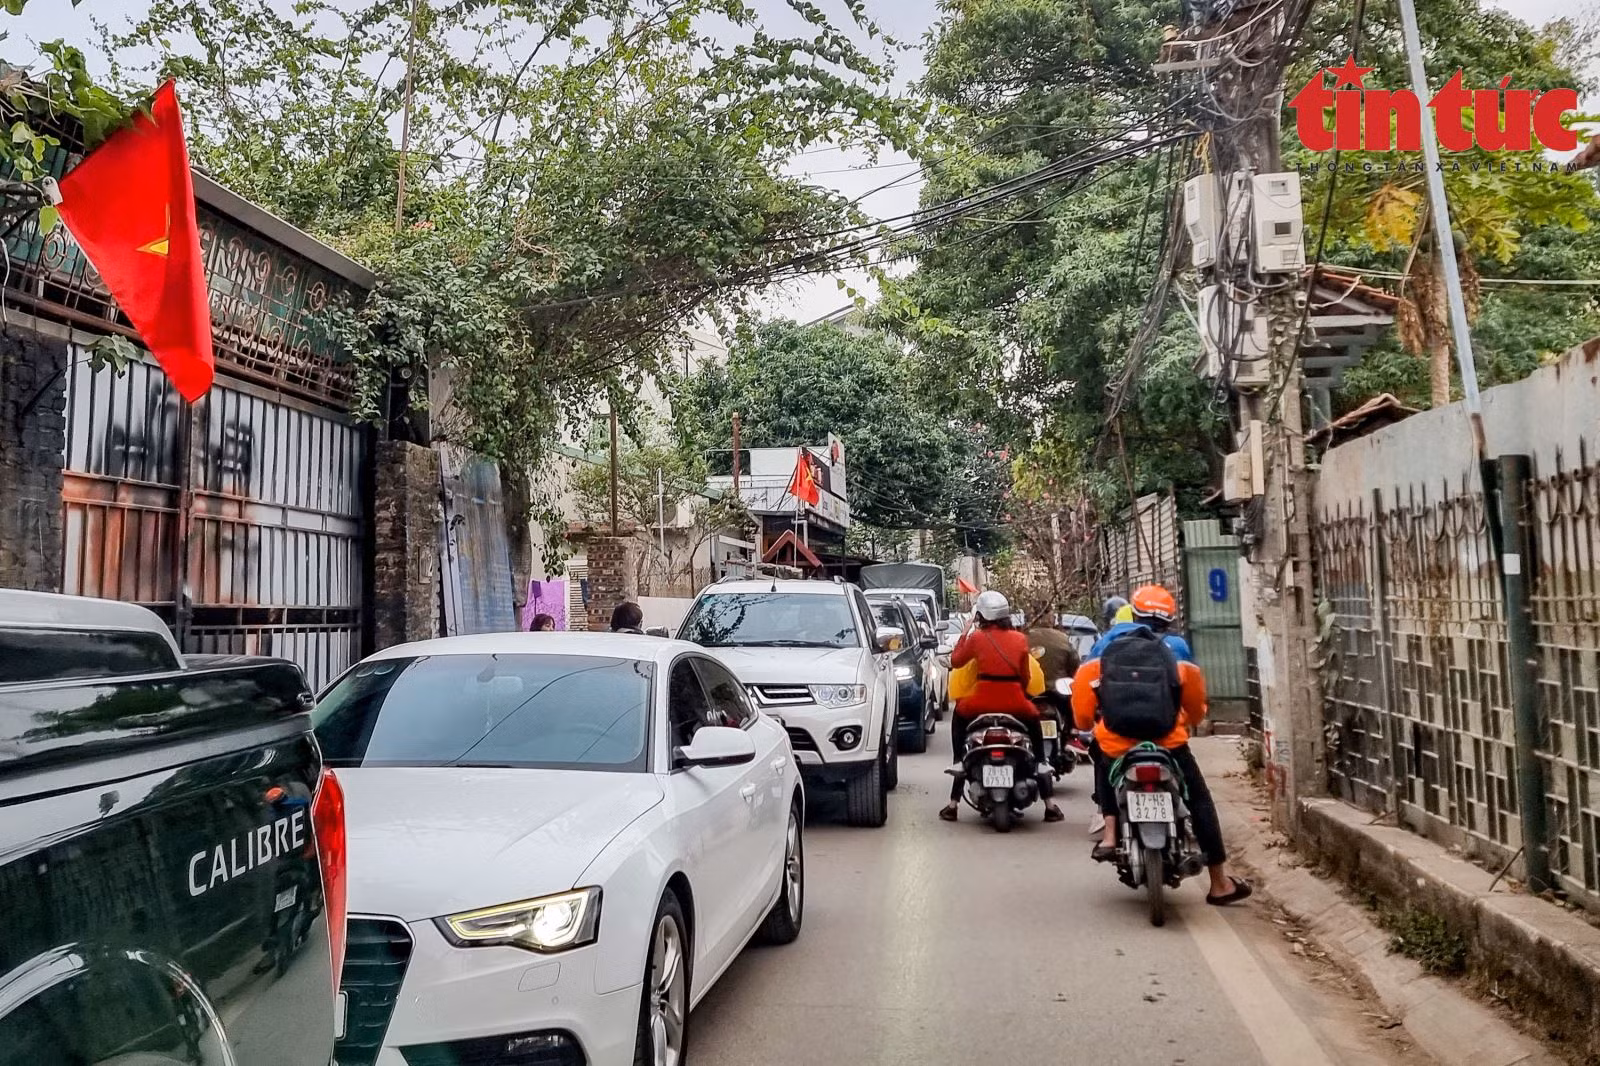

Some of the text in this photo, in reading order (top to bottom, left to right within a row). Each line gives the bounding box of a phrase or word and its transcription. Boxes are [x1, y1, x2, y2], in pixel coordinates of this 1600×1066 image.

[1208, 568, 1227, 602] 9
[1136, 807, 1167, 819] 3278
[188, 811, 304, 897] CALIBRE
